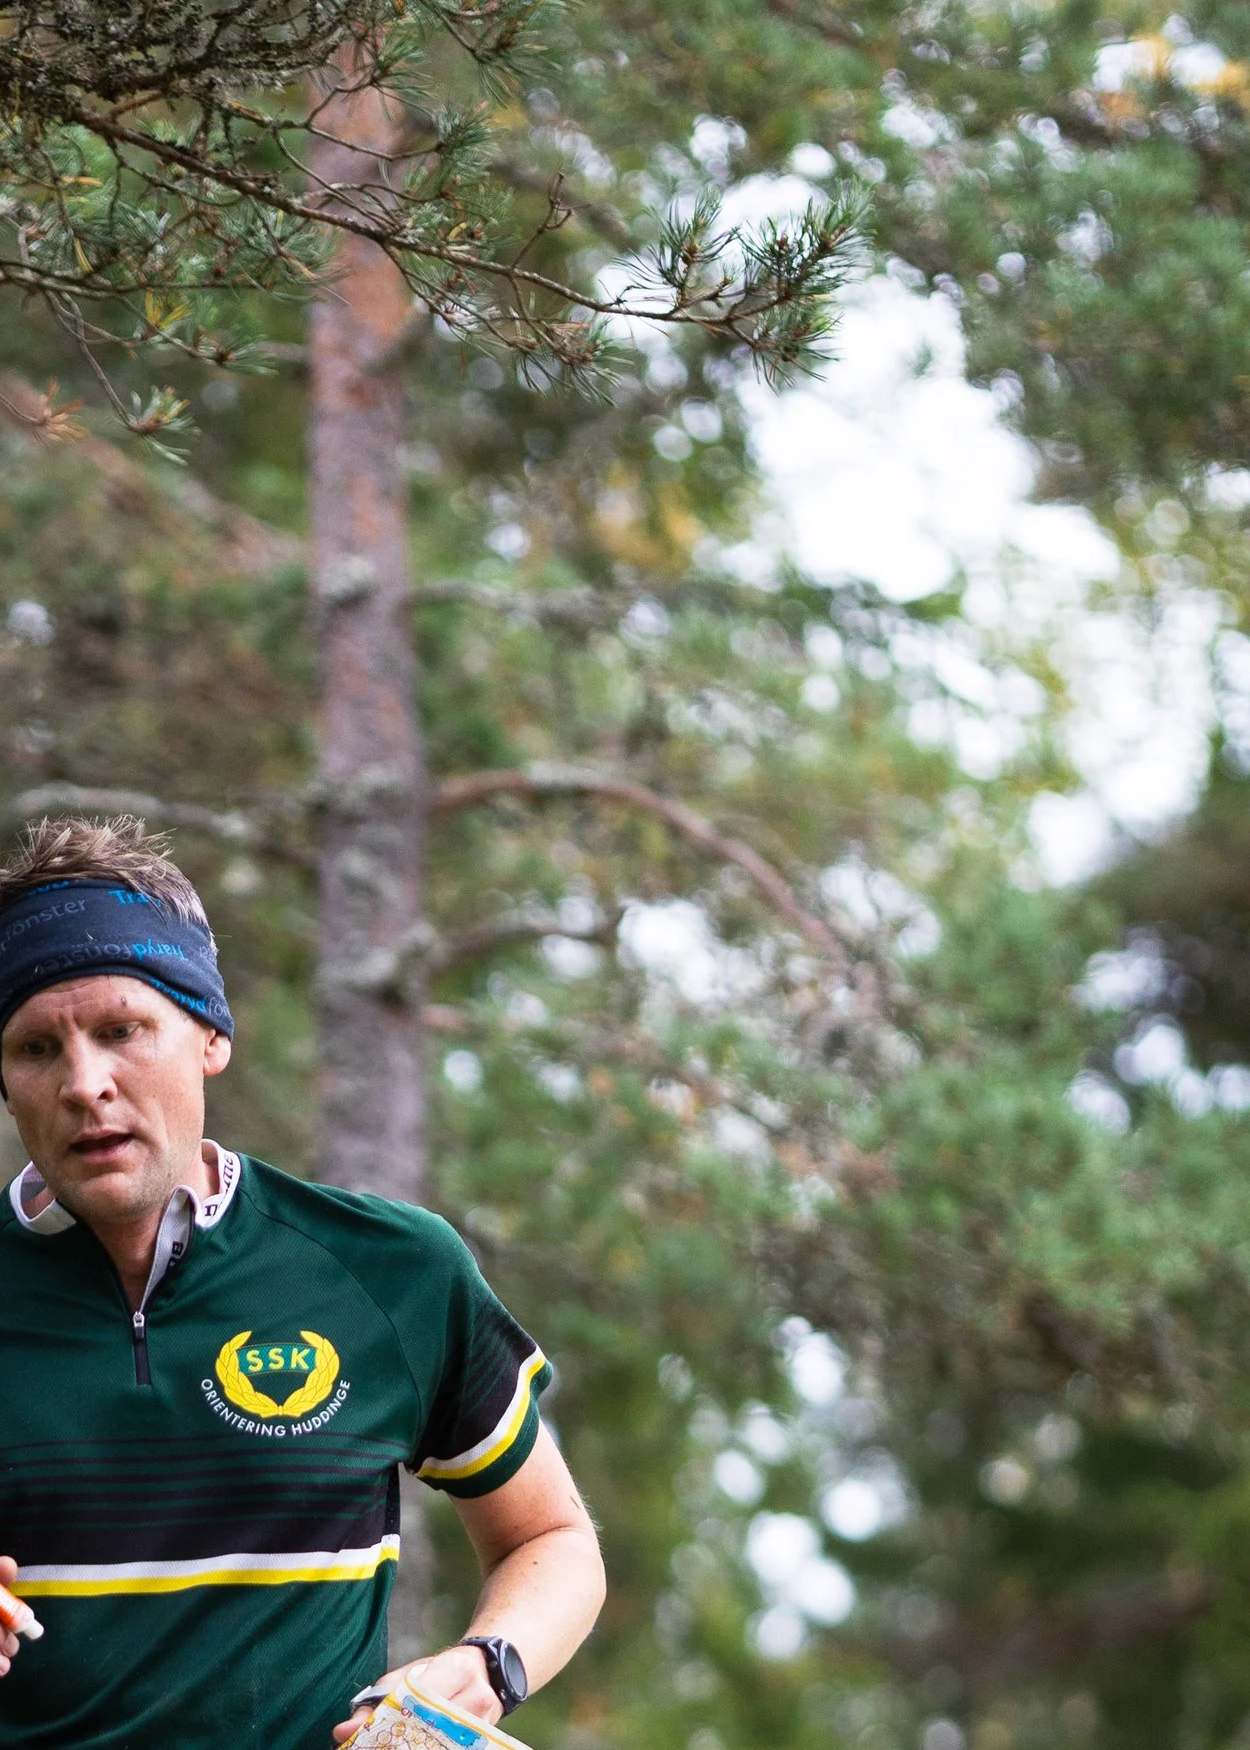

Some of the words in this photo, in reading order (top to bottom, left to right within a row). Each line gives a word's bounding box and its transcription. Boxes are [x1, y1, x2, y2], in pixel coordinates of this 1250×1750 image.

[246, 1347, 311, 1372] SSK
[201, 1378, 286, 1437] ORIENTERING
[291, 1379, 350, 1436] HUDDINGE
